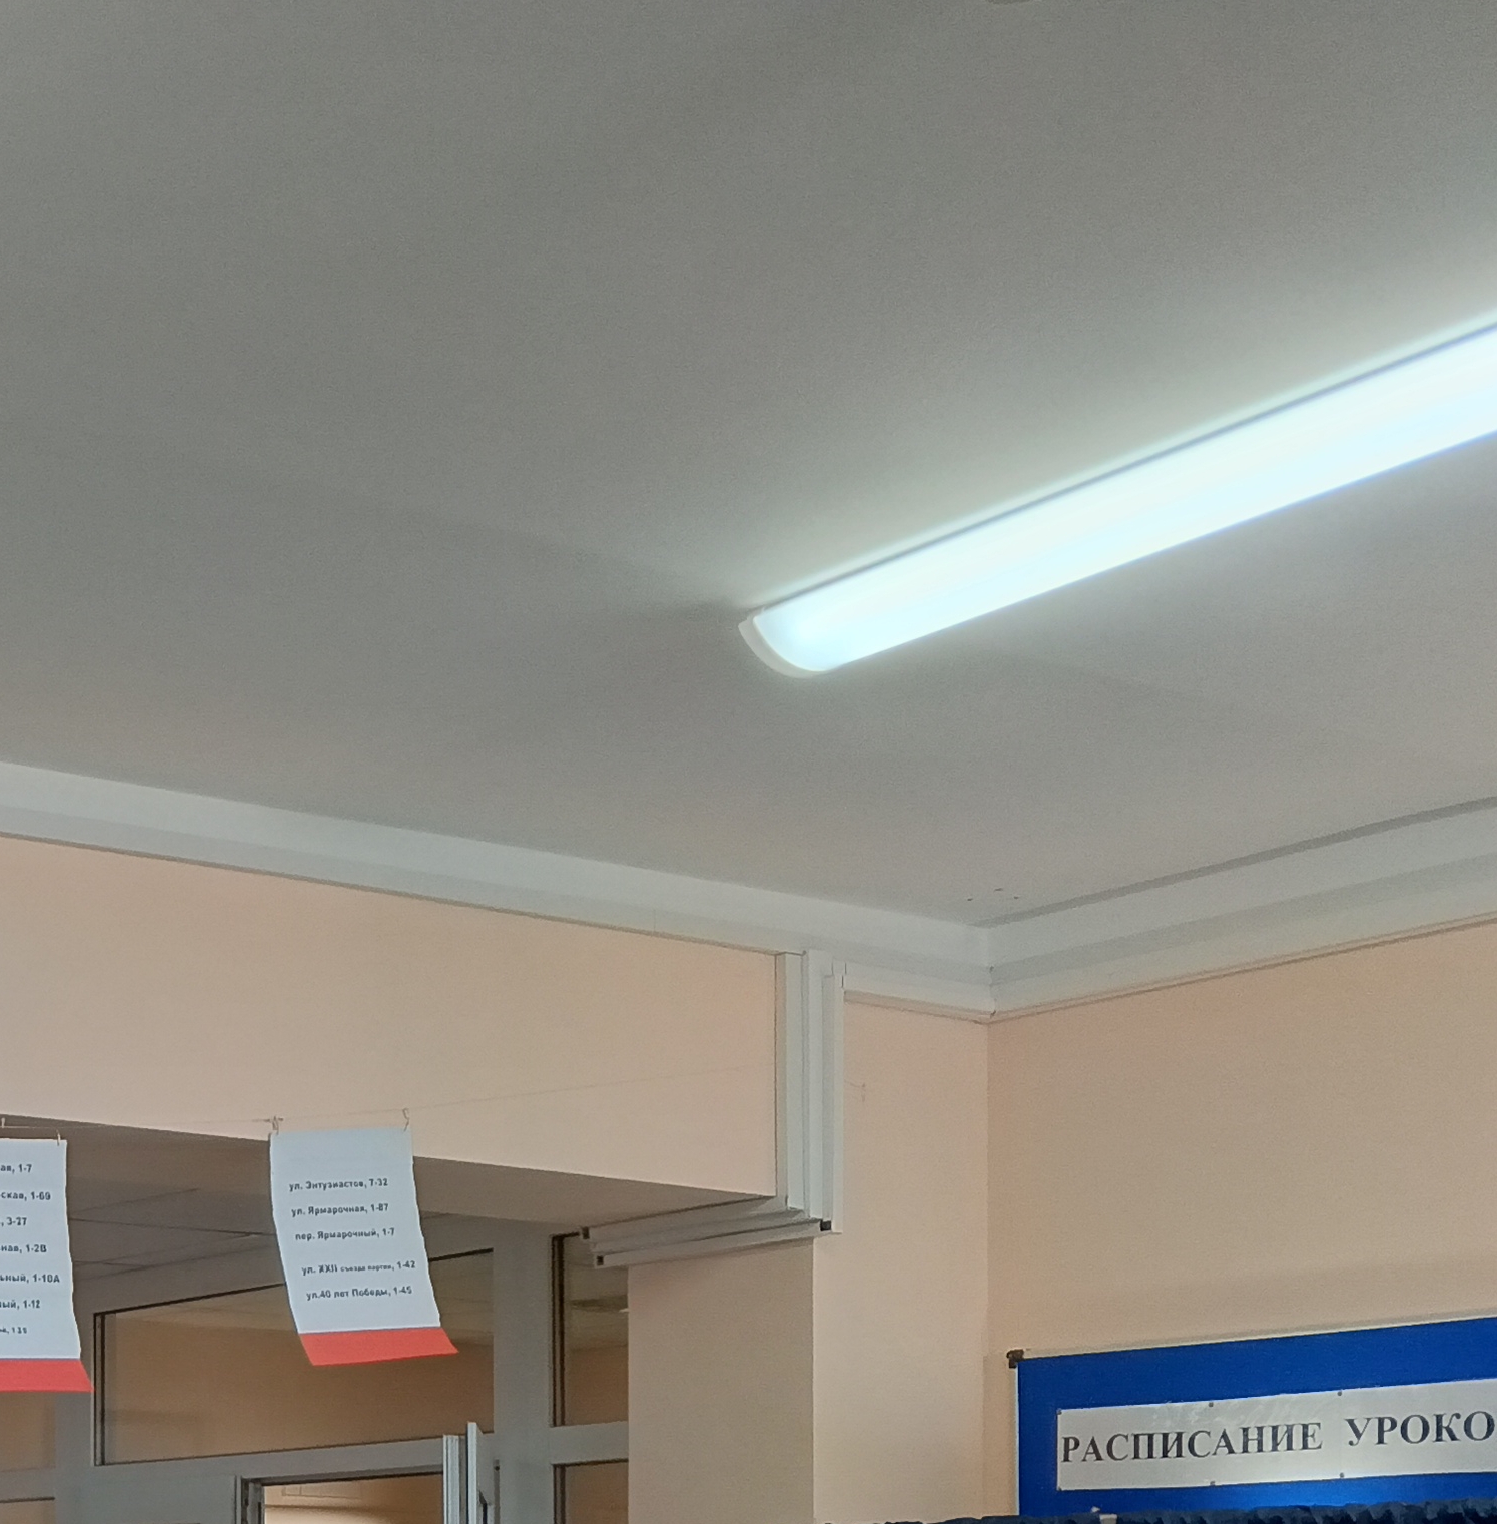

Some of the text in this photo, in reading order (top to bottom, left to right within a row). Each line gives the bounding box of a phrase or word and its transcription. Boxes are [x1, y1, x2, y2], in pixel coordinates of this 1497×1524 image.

[19, 1164, 32, 1172] 1-7
[289, 1184, 303, 1192] ул.
[306, 1181, 367, 1191] Энтузиастов,
[291, 1209, 305, 1217] ул.
[308, 1206, 367, 1216] Ярмарочная,
[7, 1217, 27, 1225] 3-27
[295, 1227, 394, 1241] пер. Ярмарочный, 1-7
[302, 1267, 316, 1276] ул.
[397, 1260, 415, 1269] 1-42
[352, 1288, 391, 1297] Победы,
[1060, 1410, 1495, 1463] РАСПИСАНИЕ УРОКО
